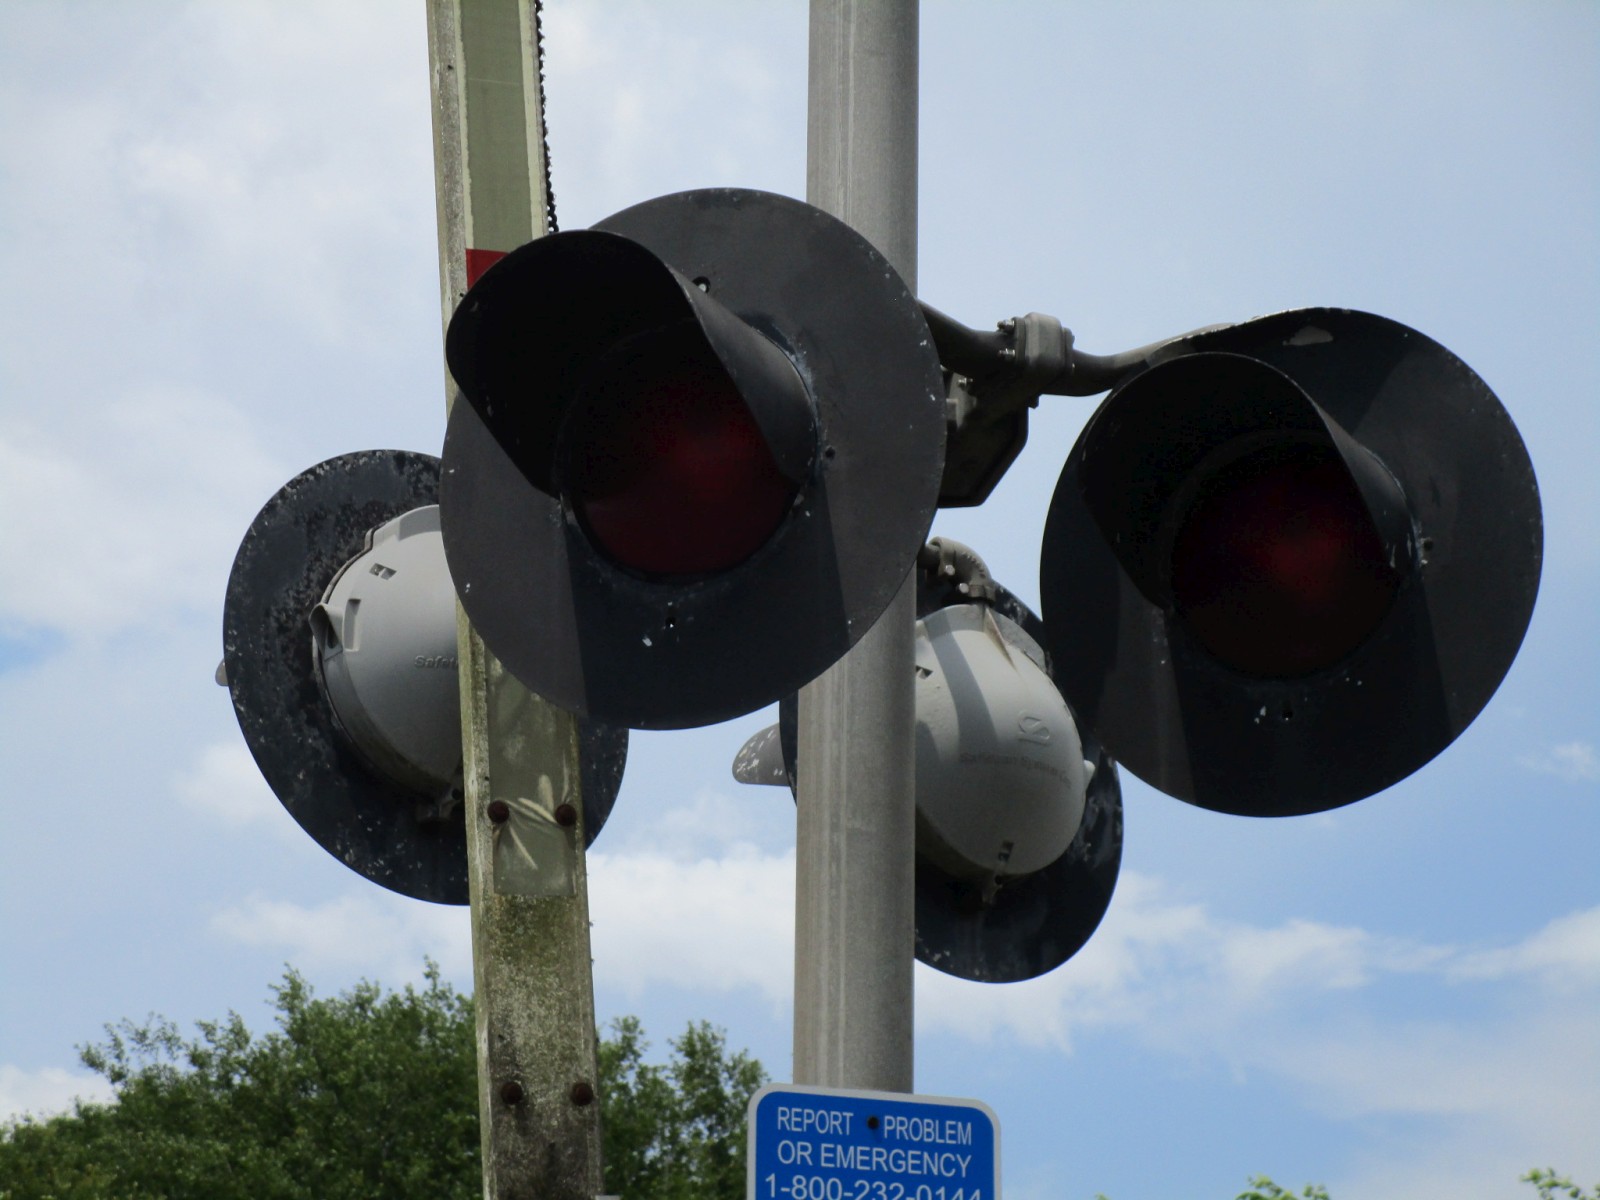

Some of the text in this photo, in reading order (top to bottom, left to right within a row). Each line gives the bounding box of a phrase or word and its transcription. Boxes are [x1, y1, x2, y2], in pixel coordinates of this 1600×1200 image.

[777, 1106, 972, 1145] REPORT PROBLEM
[777, 1140, 972, 1178] OR EMERGENCY
